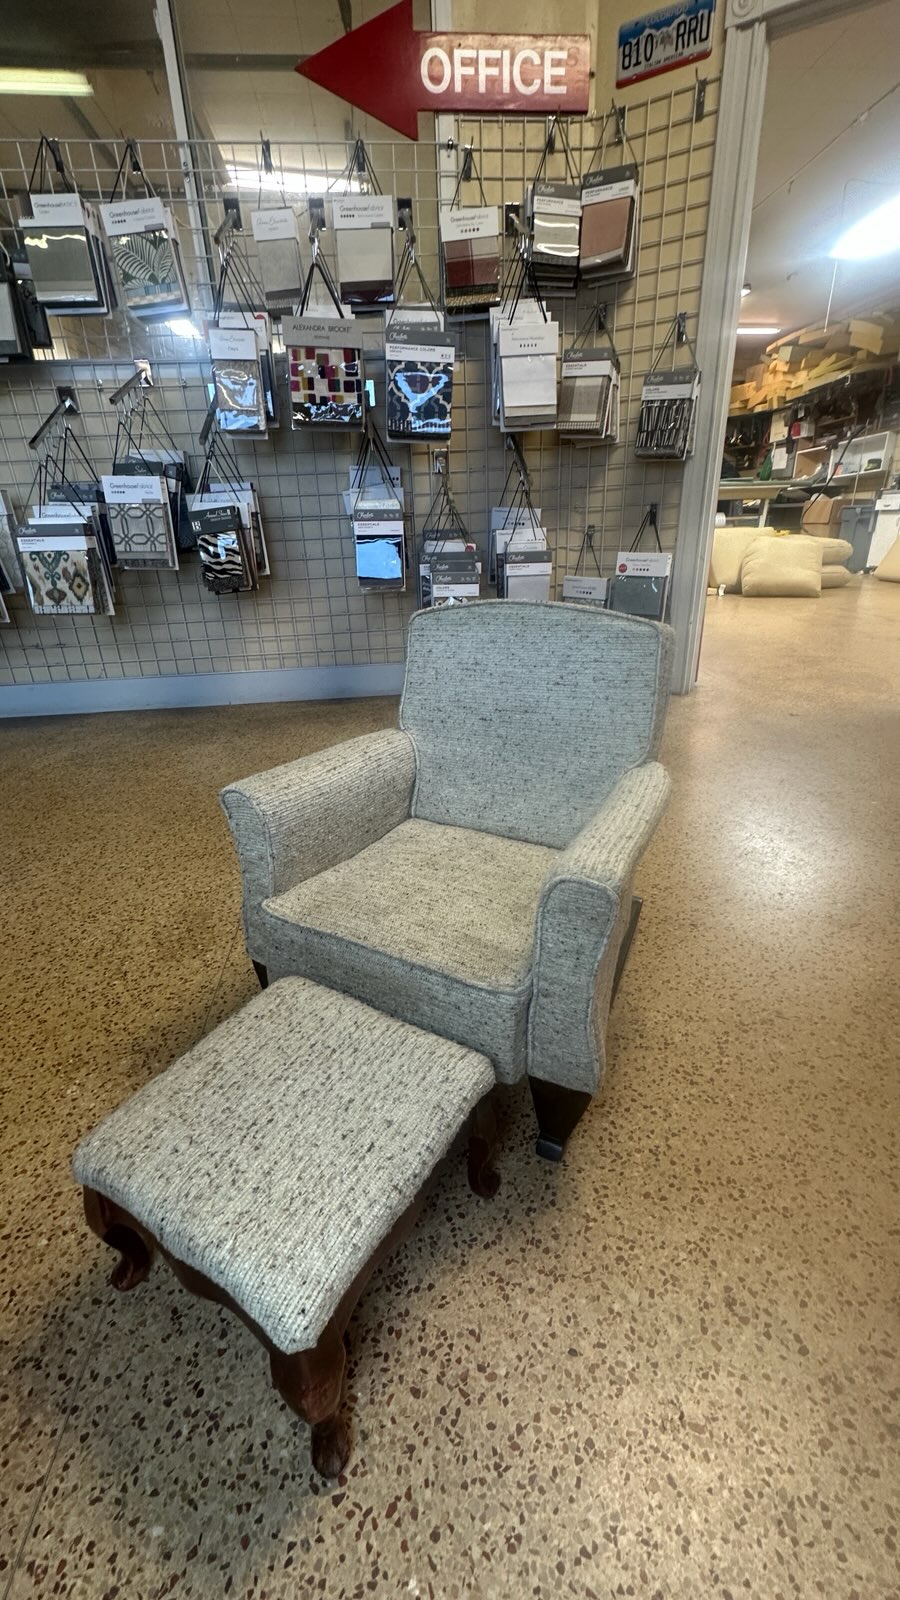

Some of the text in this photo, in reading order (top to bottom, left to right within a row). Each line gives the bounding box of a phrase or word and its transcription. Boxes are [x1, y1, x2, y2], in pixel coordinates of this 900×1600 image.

[621, 10, 712, 71] 810 RRU
[420, 47, 569, 96] OFFICE
[292, 323, 326, 332] ALEXANDRA
